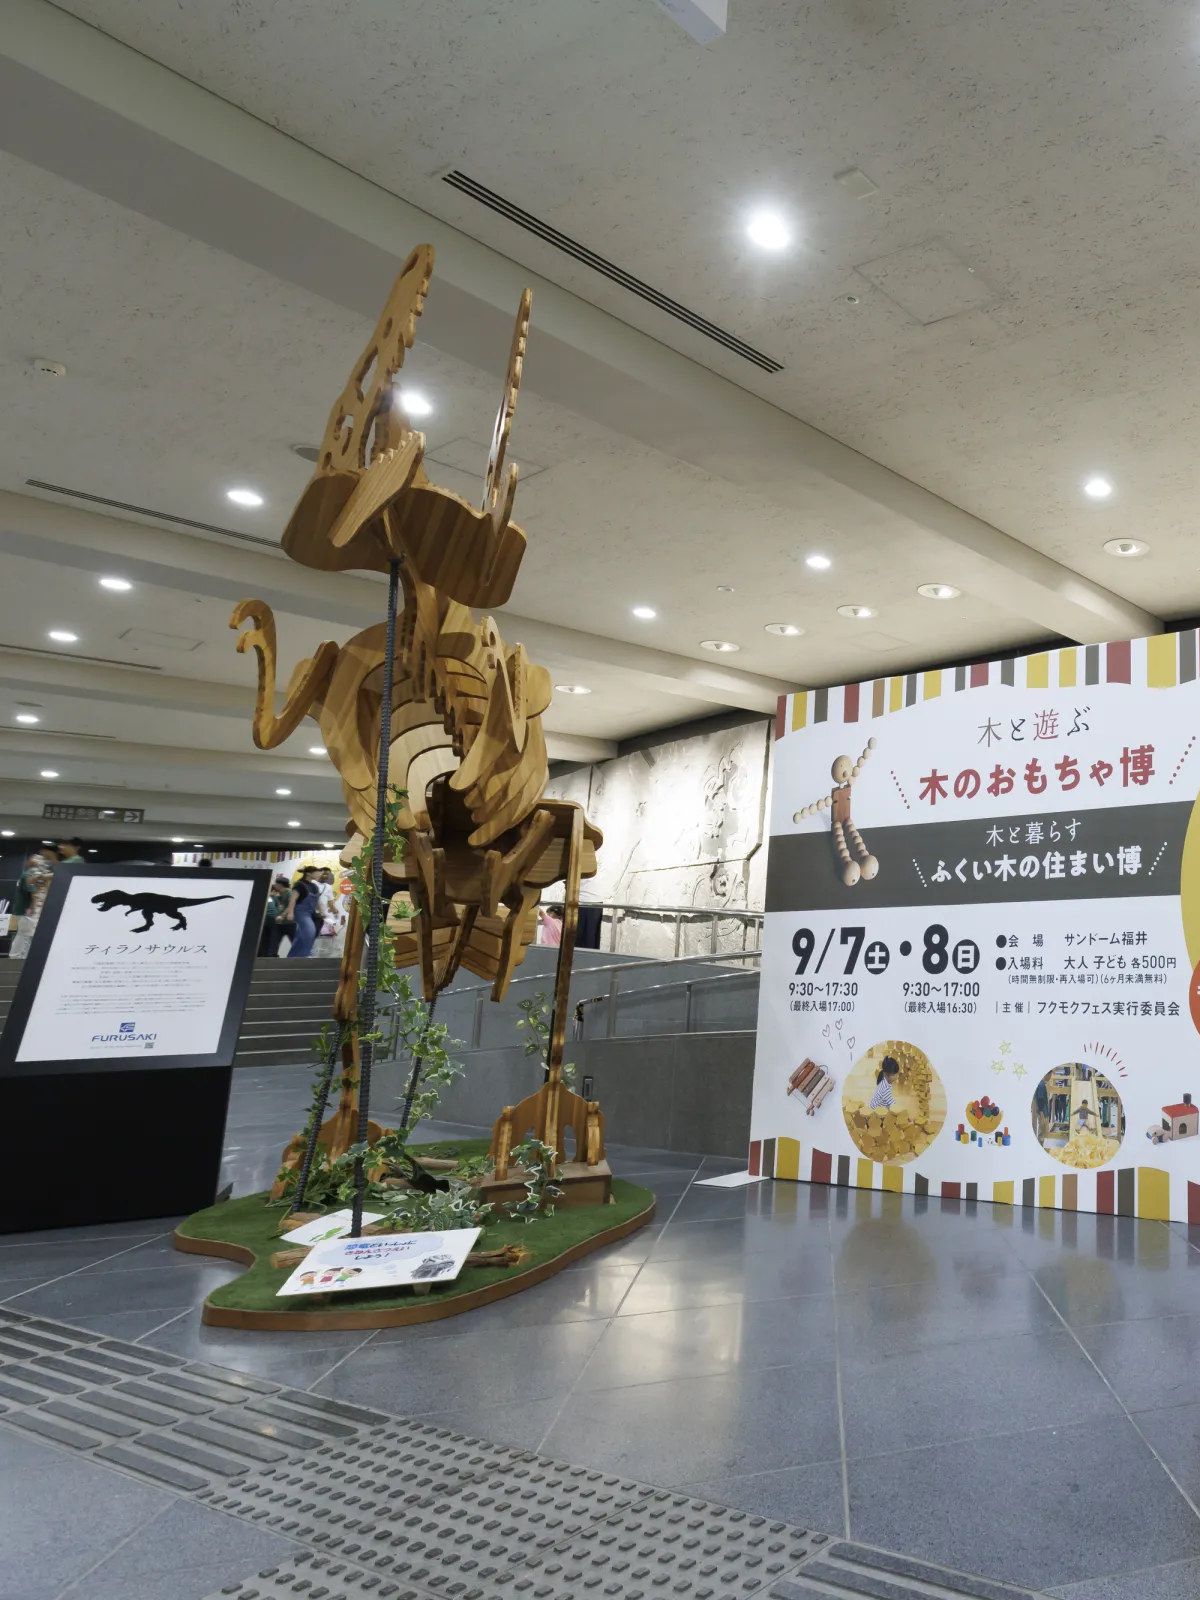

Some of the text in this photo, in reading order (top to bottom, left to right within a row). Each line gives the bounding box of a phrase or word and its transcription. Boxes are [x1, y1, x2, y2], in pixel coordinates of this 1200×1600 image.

[977, 706, 1092, 747] 木と遊ぶ
[918, 744, 1156, 805] 木のおもちゃ博
[985, 818, 1082, 847] 木と暮らす
[931, 846, 1142, 885] ふくい木の住まい博
[1064, 931, 1148, 947] サンドーム福井
[84, 944, 208, 955] ティラノサウルス
[1007, 954, 1177, 970] 入場料 大人 子ども 各500円
[789, 1000, 855, 1013] (最終入場17:00)
[904, 1001, 977, 1014] (最終入場16:30)
[1037, 1001, 1180, 1016] フクモクフェス実行委員会
[91, 1033, 157, 1042] FURUSAKI
